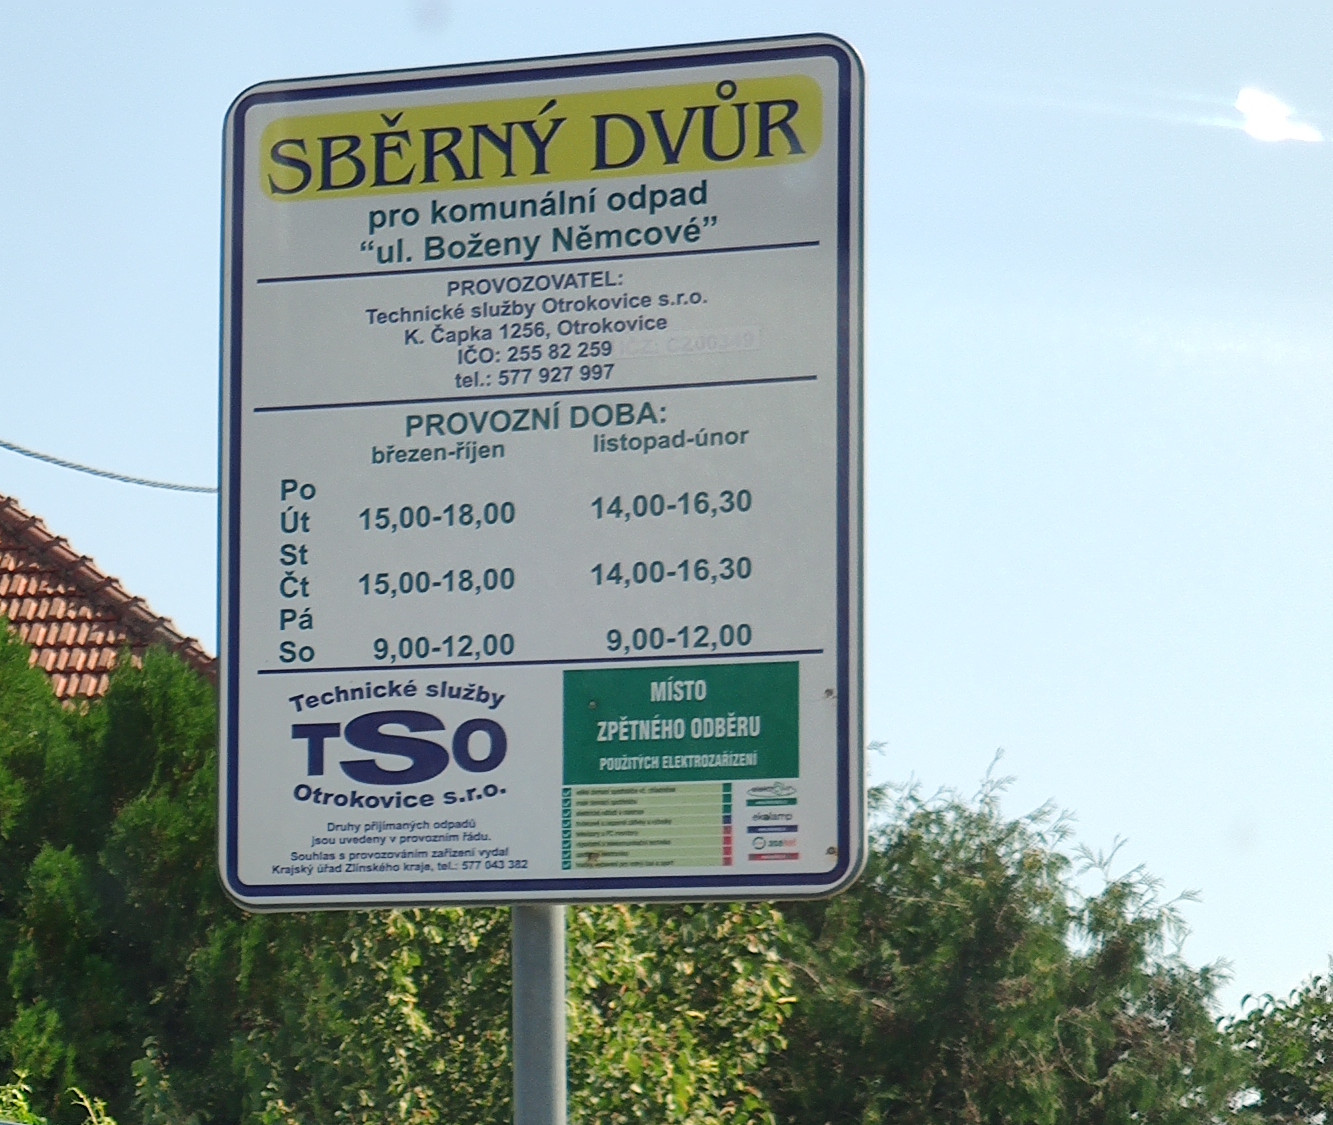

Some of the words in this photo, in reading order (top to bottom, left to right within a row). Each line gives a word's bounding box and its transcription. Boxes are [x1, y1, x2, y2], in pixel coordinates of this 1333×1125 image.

[267, 98, 566, 195] SBĚRNÝ
[592, 79, 805, 172] DVŮR
[369, 207, 420, 235] pro
[431, 188, 596, 223] komunální
[607, 180, 708, 210] odpad
[424, 231, 541, 266] Boženy
[447, 271, 623, 297] PROVOZOVATEL:
[366, 304, 465, 324] Technické
[471, 302, 537, 322] služby
[542, 295, 651, 315] Otrokovice
[659, 291, 708, 308] s.r.o.
[404, 328, 424, 344] K.
[431, 323, 494, 346] Čapka
[499, 321, 551, 342] 1256,
[557, 314, 667, 336] Otrokovice
[457, 344, 501, 364] IČO:
[507, 345, 541, 362] 255
[547, 344, 572, 360] 82
[577, 341, 613, 358] 259
[455, 371, 492, 388] tel.:
[498, 370, 533, 385] 577
[538, 367, 574, 383] 927
[579, 364, 614, 381] 997
[405, 403, 560, 438] PROVOZNÍ
[570, 405, 667, 429] DOBA:
[371, 441, 505, 464] březen-říjen
[593, 427, 749, 454] listopad-únor
[281, 479, 316, 500] Po
[359, 503, 515, 533] 15,00-18,00
[592, 490, 752, 522] 14,00-16,30
[281, 509, 310, 533] Út
[281, 544, 308, 565] St
[280, 573, 309, 598] Čt
[358, 568, 515, 598] 15,00-18,00
[591, 557, 752, 589] 14,00-16,30
[280, 607, 313, 630] Pá
[373, 634, 514, 663] 9,00-12,00
[607, 623, 752, 653] 9,00-12,00
[279, 642, 315, 663] So
[289, 681, 417, 713] Technické
[425, 681, 506, 709] služby
[650, 677, 707, 703] MÍSTO
[597, 715, 685, 742] ZPĚTNÉHO
[691, 712, 760, 738] ODBĚRU
[291, 710, 508, 785] TSO
[599, 751, 659, 770] POUŽITÝCH
[662, 749, 758, 768] ELEKTROZAŘÍZENÍ
[293, 784, 435, 809] Otrokovice
[442, 784, 507, 805] s.r.o.
[311, 836, 335, 847] jsou
[339, 835, 386, 845] uvedeny
[399, 832, 459, 845] provozním
[462, 831, 491, 841] řádu.
[327, 822, 361, 833] Druhy
[364, 820, 429, 833] přijímaných
[433, 819, 476, 831] odpadů
[291, 851, 335, 861] Souhlas
[349, 849, 428, 861] provozováním
[431, 848, 475, 858] zařízení
[478, 847, 509, 858] vydal
[272, 864, 313, 876] Krajský
[316, 863, 342, 873] úřad
[345, 862, 400, 873] Zlínského
[403, 862, 433, 873] kraje,
[437, 862, 458, 871] tel.:
[462, 860, 481, 870] 577
